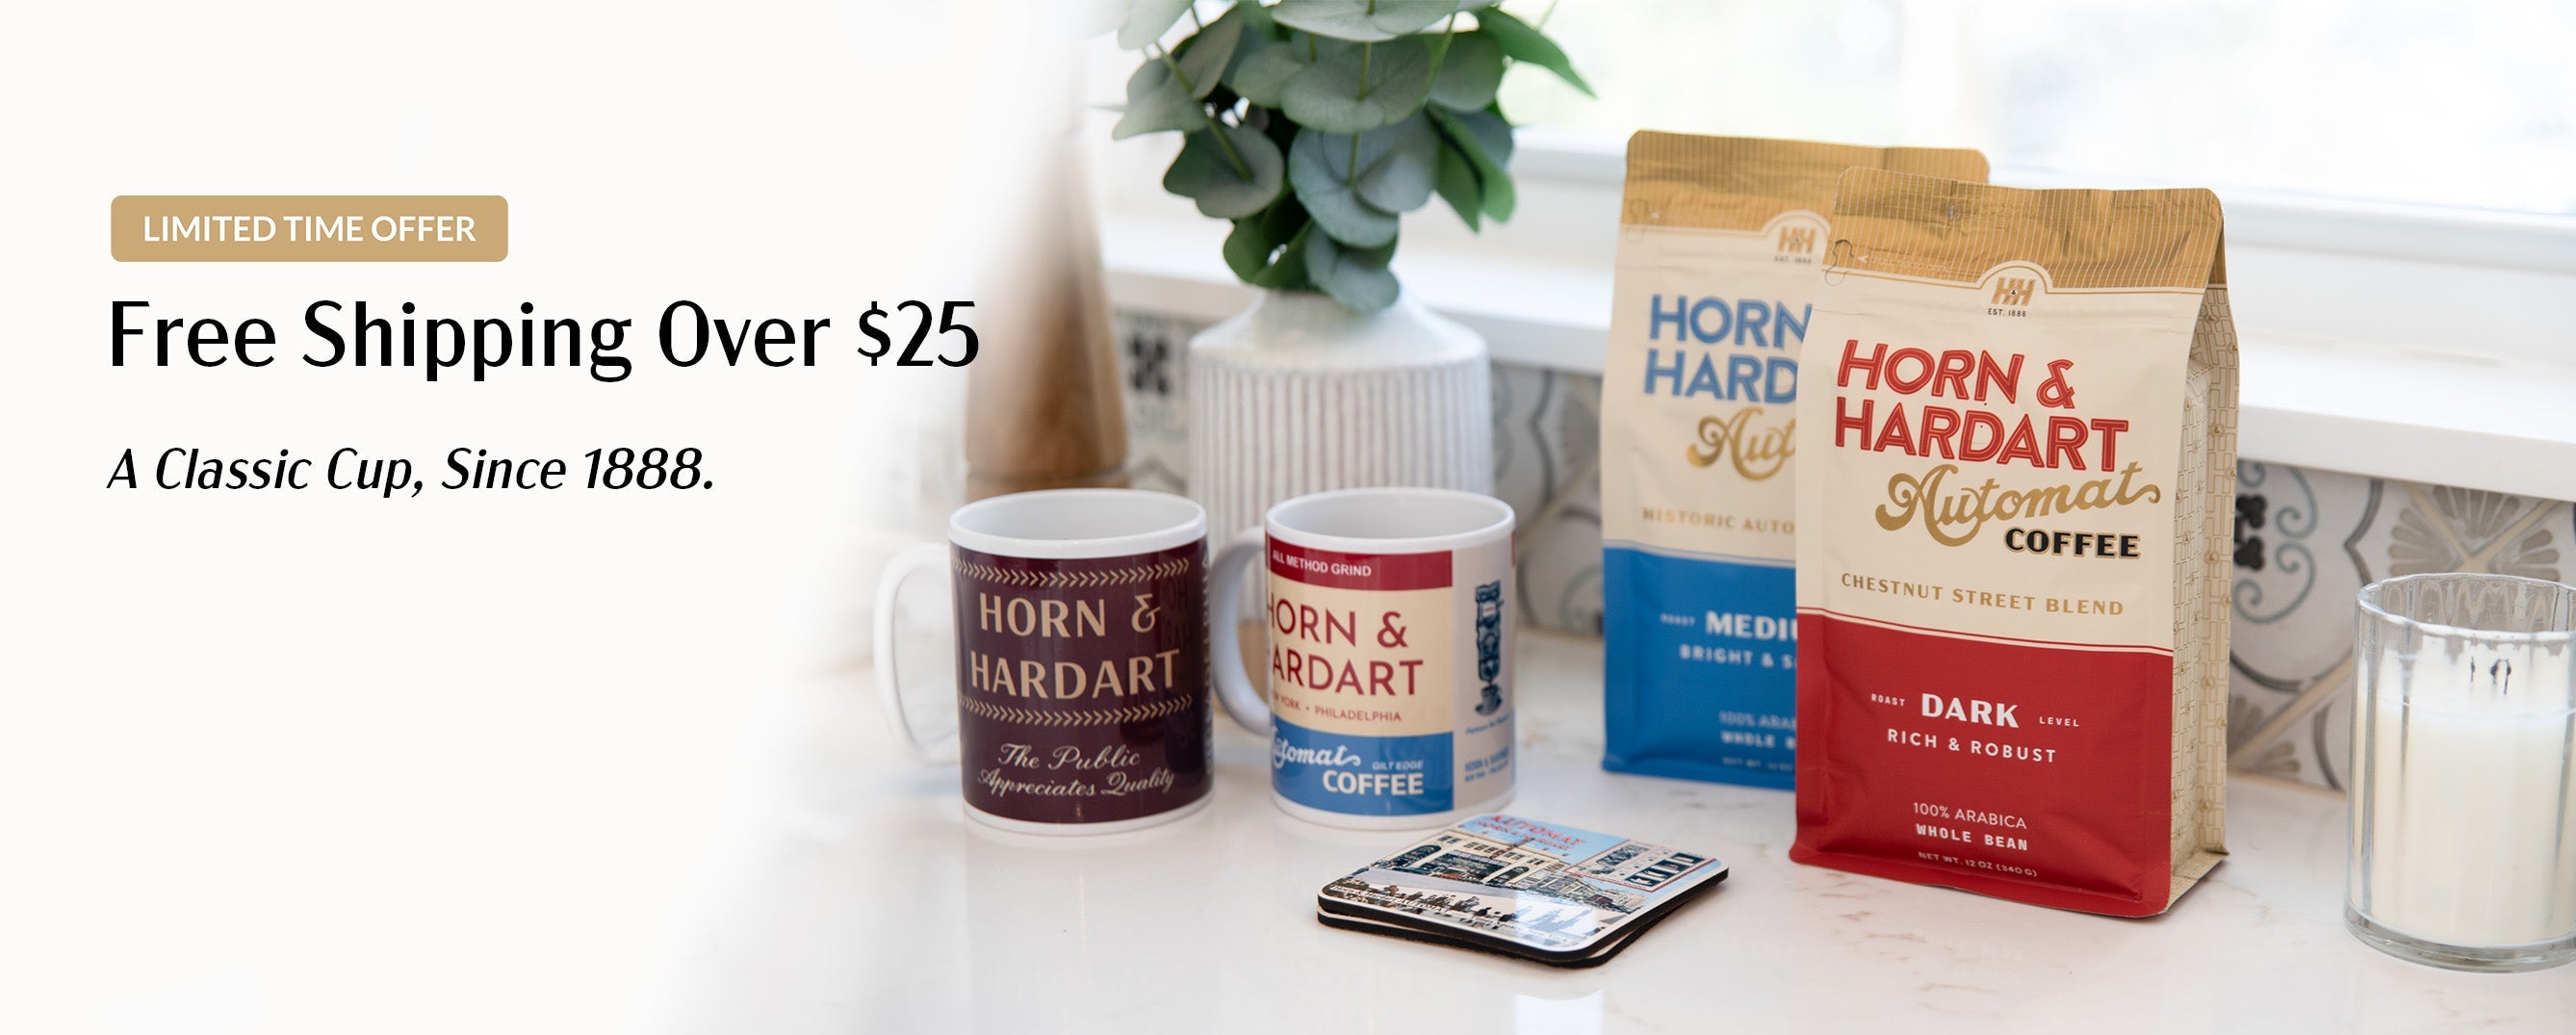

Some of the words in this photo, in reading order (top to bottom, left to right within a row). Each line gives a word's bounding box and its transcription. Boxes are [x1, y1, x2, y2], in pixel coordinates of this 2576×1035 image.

[1649, 294, 1814, 350] HORN
[1988, 307, 2005, 318] EST.
[2008, 309, 2026, 318] 1888
[1644, 349, 1799, 404] HARD
[1837, 339, 2024, 404] HORN
[2037, 358, 2075, 409] &
[1835, 396, 2129, 472] HARDART
[1642, 506, 1735, 529] HISTORIC
[1874, 461, 2161, 547] Automat
[2003, 527, 2141, 559] COFFEE
[1273, 550, 1285, 563] ALL
[1286, 555, 1328, 574] METHOD
[1331, 563, 1372, 578] GRIND
[1842, 572, 1944, 600] CHESTNUT
[1952, 588, 2036, 611] STREET
[2046, 598, 2125, 615] BLEND
[979, 591, 1106, 637] HORN
[1131, 593, 1161, 633] &
[1377, 610, 1408, 649] &
[1273, 643, 1424, 696] ARDART
[1679, 643, 1753, 666] BRIGHT
[1761, 652, 1774, 668] &
[970, 648, 1180, 700] HARDART
[1279, 695, 1301, 711] YORK
[1315, 705, 1403, 722] PHILADELPHIA
[1870, 693, 1905, 707] ROAST
[1921, 692, 2020, 729] DARK
[2039, 716, 2080, 727] LEVEL
[998, 742, 1041, 769] The
[1047, 743, 1142, 770] Public
[1272, 725, 1361, 769] utomat
[1887, 728, 1938, 748] RICH
[1948, 737, 1960, 752] &
[1971, 740, 2056, 763] ROBUST
[1372, 761, 1395, 770] GILT
[1396, 760, 1425, 770] EDGE
[978, 767, 1096, 798] Appreciates
[1100, 767, 1175, 797] Quality
[1323, 769, 1425, 796] COFFEE
[1913, 802, 1950, 819] 100%
[1954, 808, 2027, 830] ARABICA
[1915, 823, 1972, 842] WHOLE
[1984, 834, 2028, 851] BEAN
[1918, 851, 1940, 861] NET
[1965, 859, 1976, 867] 12
[1977, 861, 1994, 870] OZ
